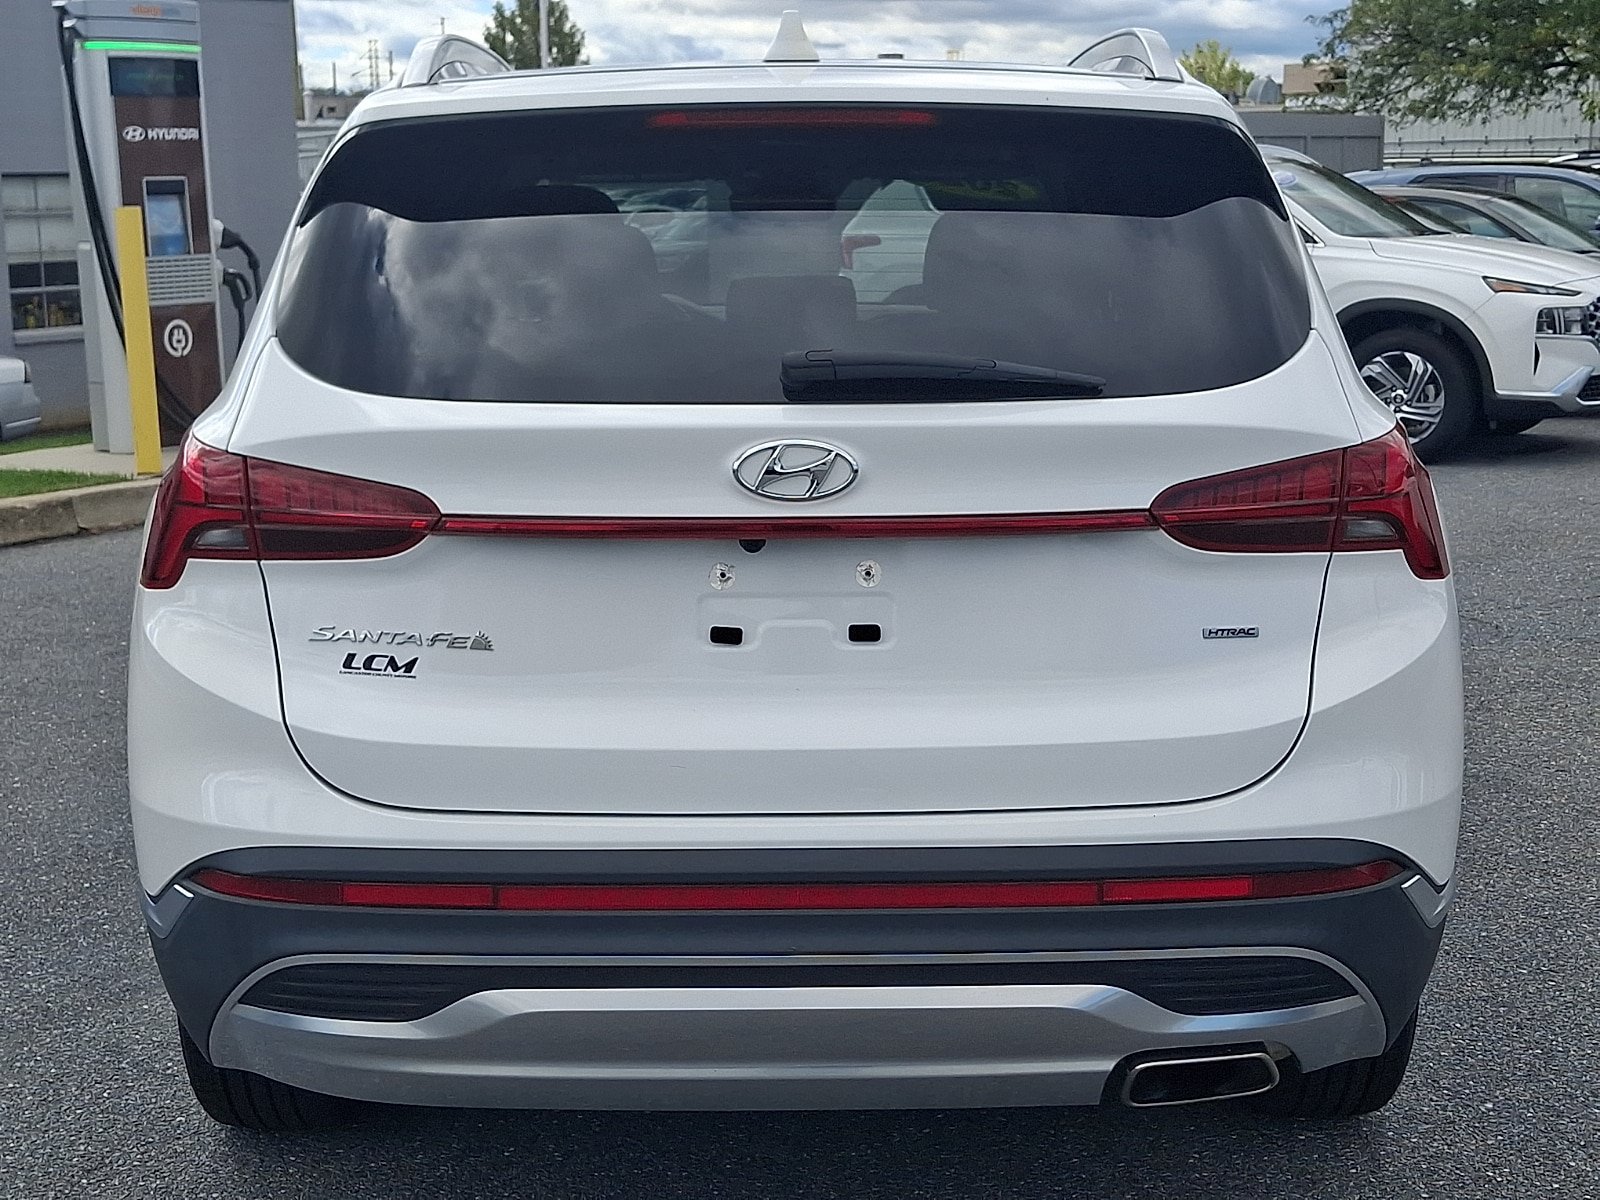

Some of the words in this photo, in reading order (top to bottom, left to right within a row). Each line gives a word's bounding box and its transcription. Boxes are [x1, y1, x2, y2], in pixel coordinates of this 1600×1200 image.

[147, 127, 199, 140] HYUNDAI
[308, 625, 423, 647] SANTA
[426, 631, 471, 649] FE
[1207, 627, 1256, 637] HTRAC
[342, 652, 419, 674] LCM
